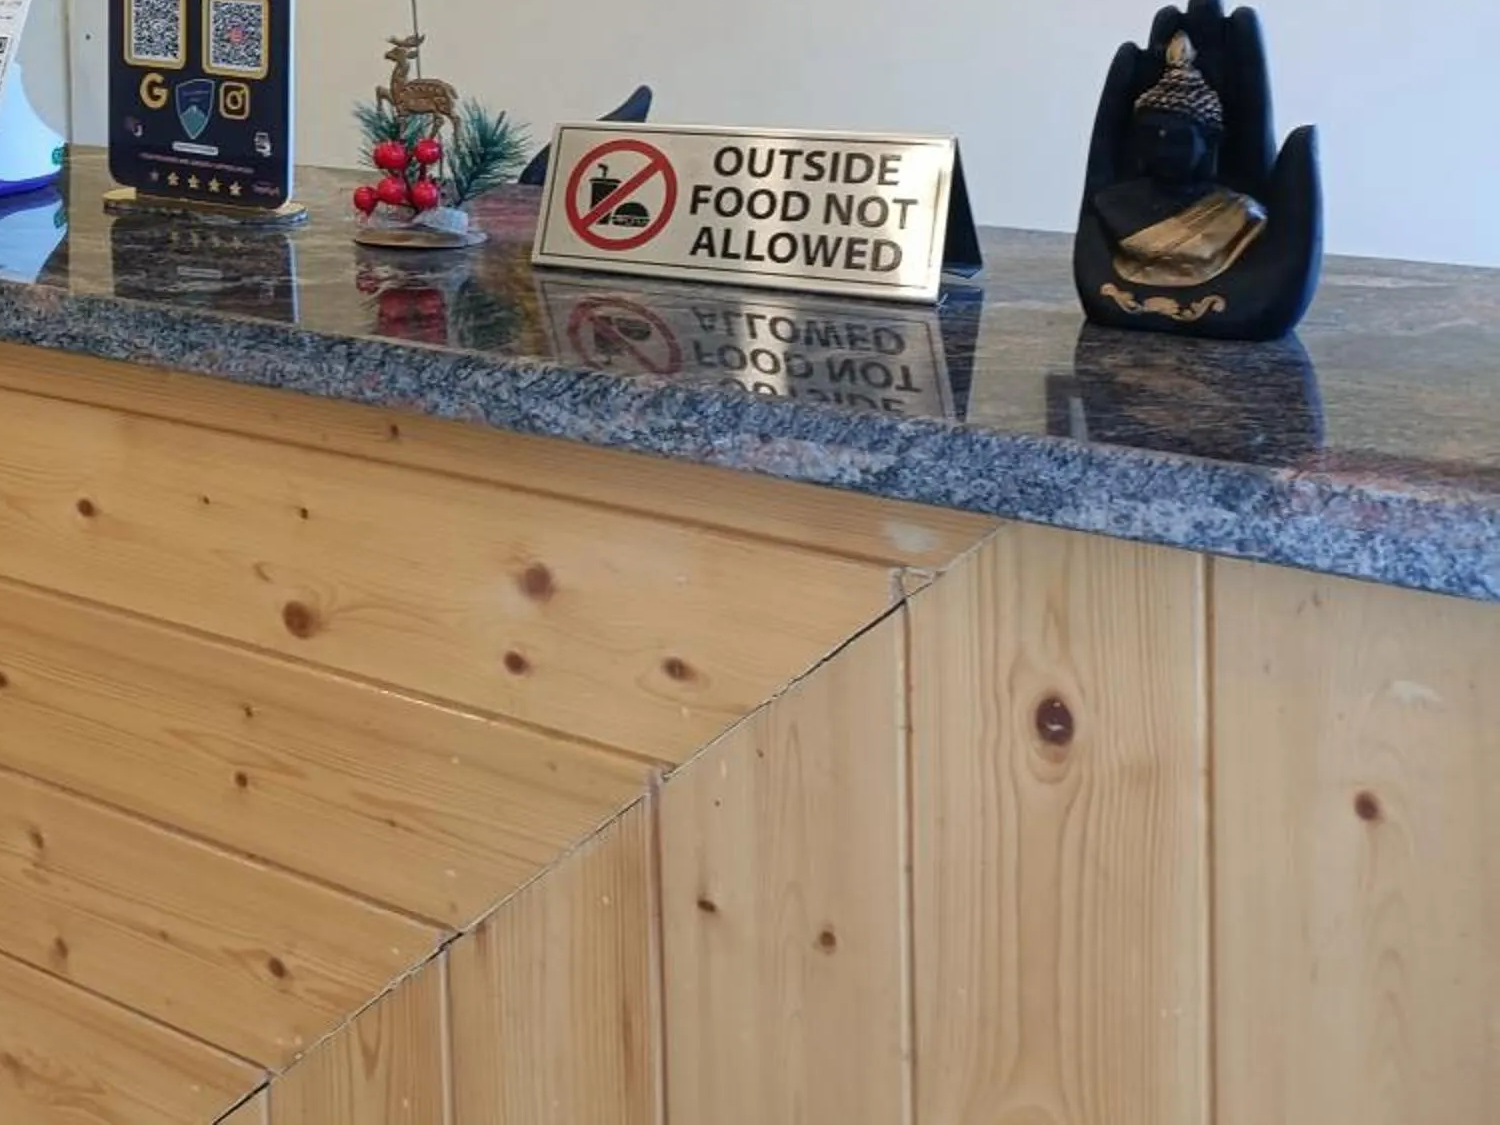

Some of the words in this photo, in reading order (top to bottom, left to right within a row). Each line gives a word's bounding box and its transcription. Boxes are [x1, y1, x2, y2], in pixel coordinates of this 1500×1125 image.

[140, 72, 169, 109] G
[713, 145, 903, 186] OUTSIDE
[689, 184, 811, 222] FOOD
[823, 192, 918, 230] NOT
[689, 225, 903, 272] ALLOWED
